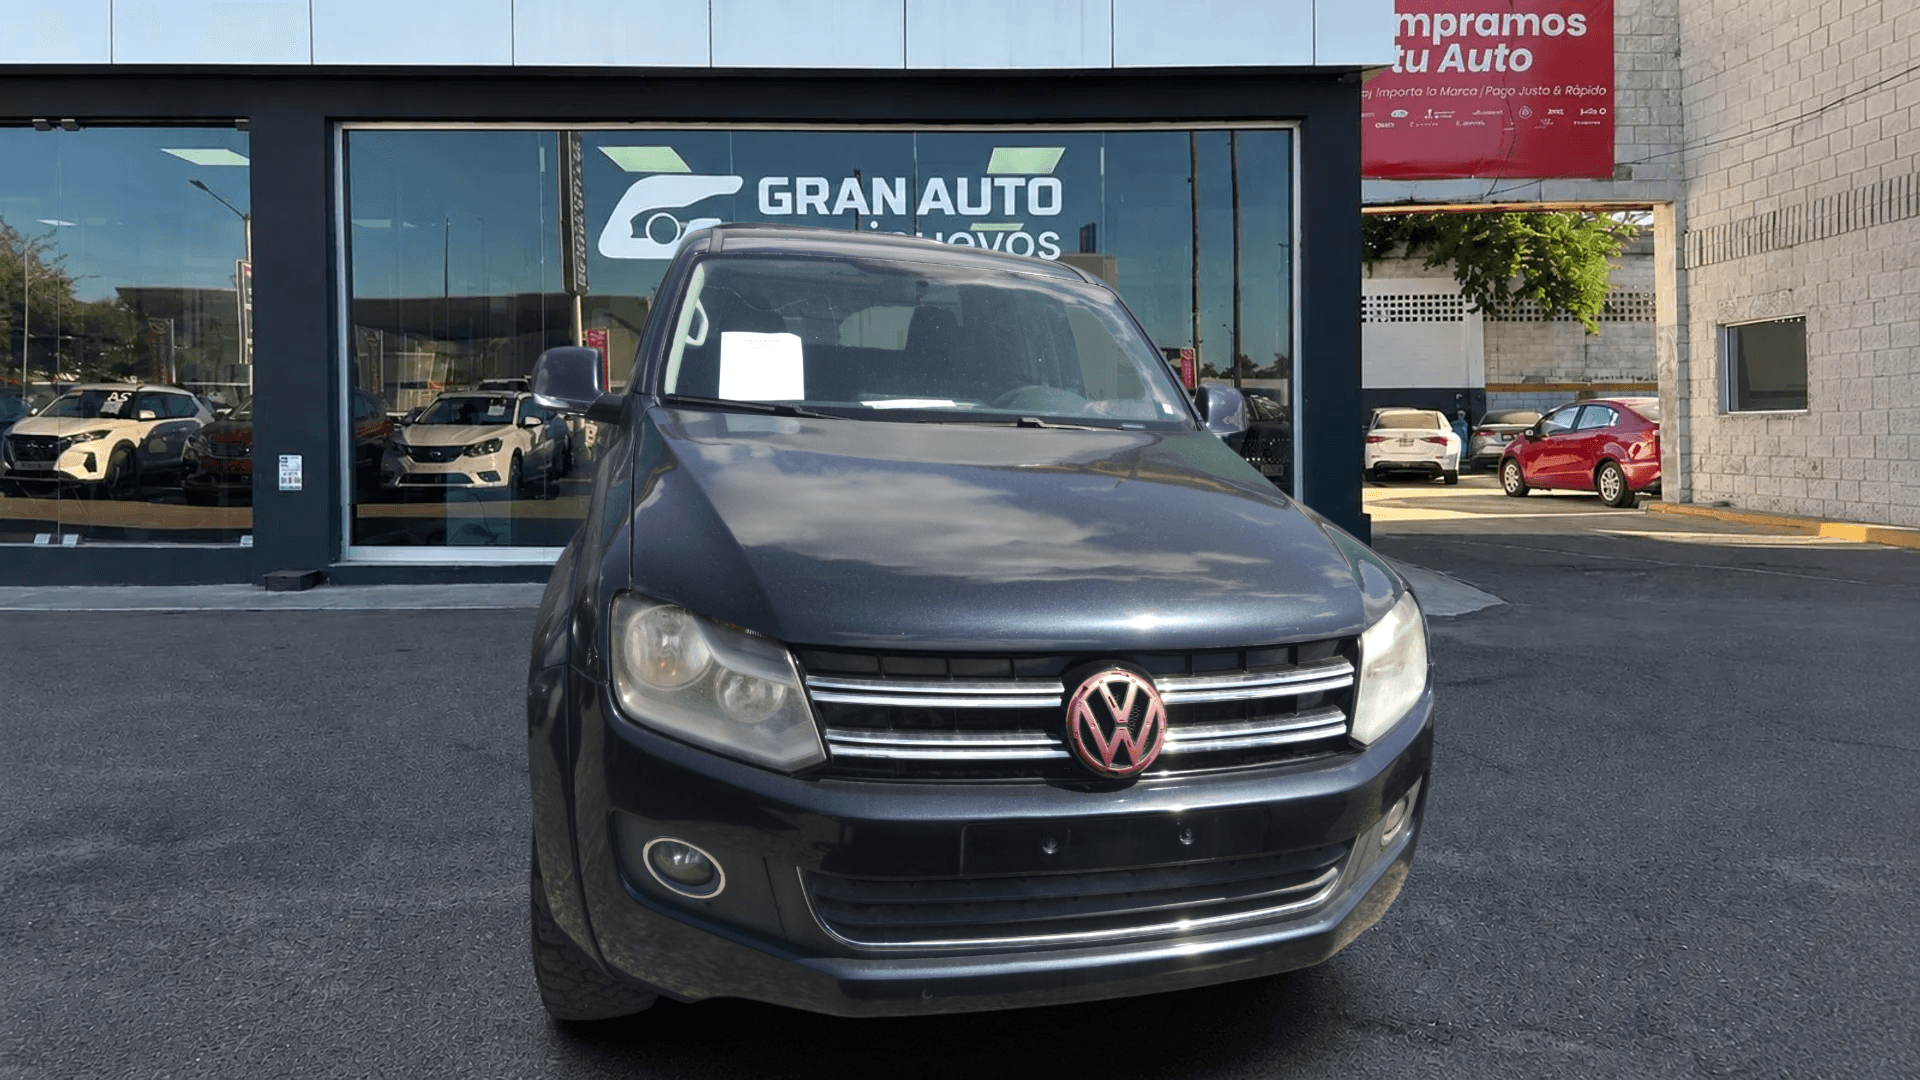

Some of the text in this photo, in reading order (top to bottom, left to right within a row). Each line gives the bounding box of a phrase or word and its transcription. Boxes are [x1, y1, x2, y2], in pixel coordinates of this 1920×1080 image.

[1392, 43, 1533, 73] tu Auto
[1519, 85, 1551, 96] Justo
[1553, 85, 1561, 96] &
[1565, 84, 1607, 98] Rápido
[758, 176, 1063, 216] GRAN AUTO
